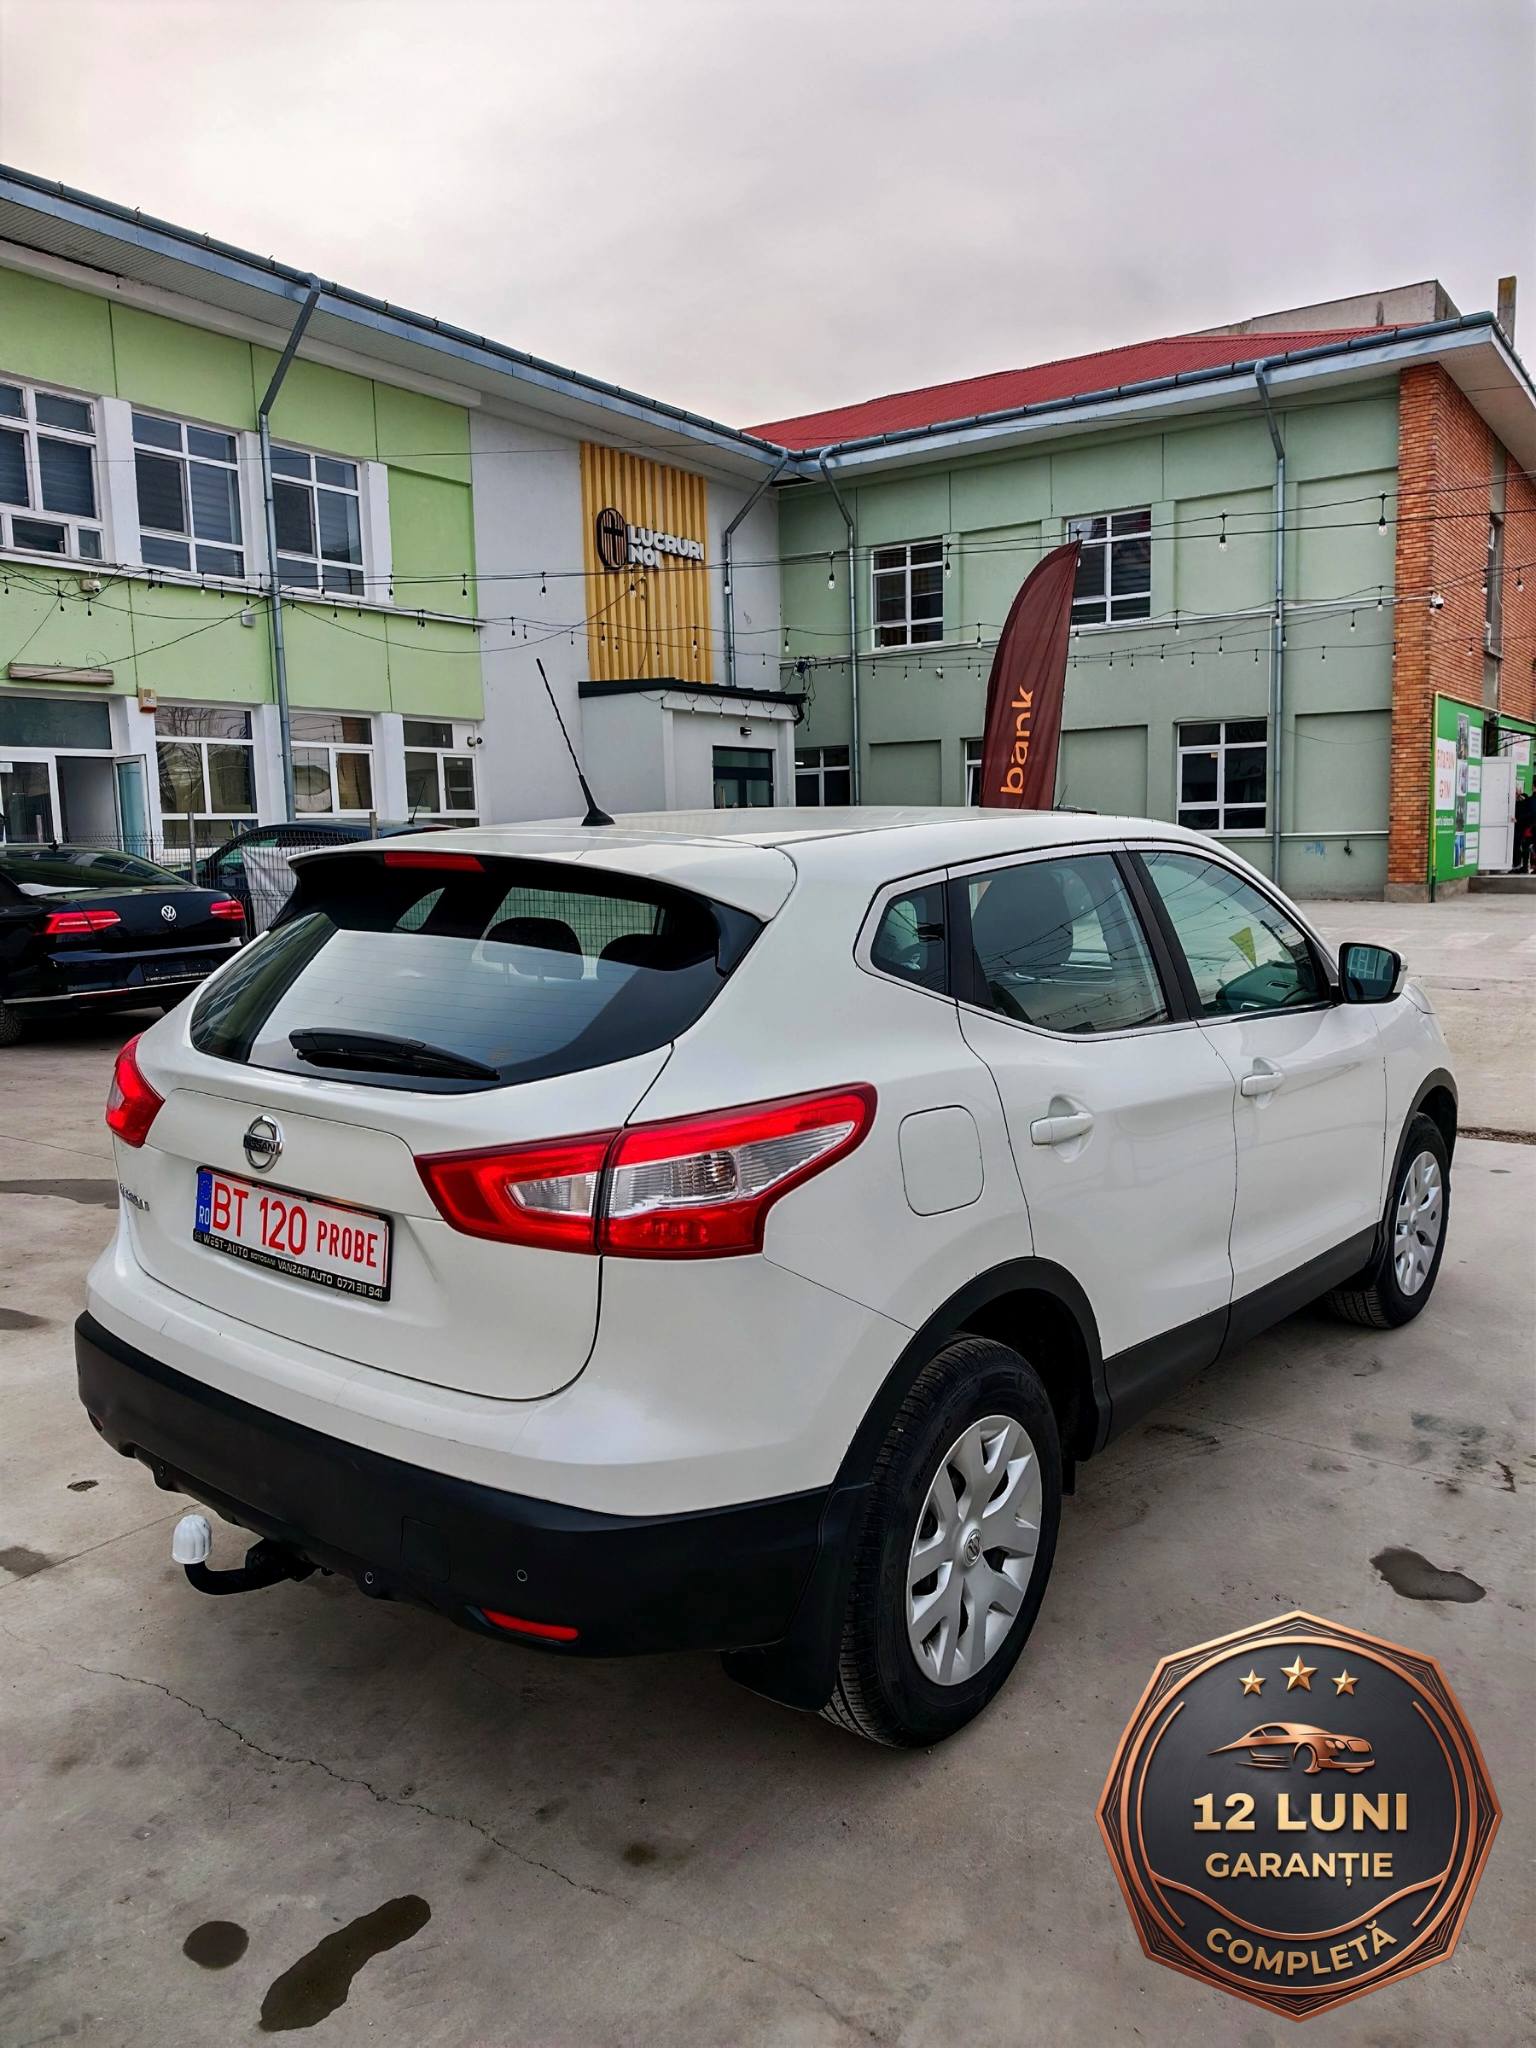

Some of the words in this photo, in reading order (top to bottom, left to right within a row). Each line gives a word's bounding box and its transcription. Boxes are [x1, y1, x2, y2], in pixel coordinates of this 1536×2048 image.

[628, 524, 704, 560] LUCRURI
[628, 544, 662, 568] NOI
[1000, 685, 1033, 794] bank
[199, 1205, 210, 1225] RO
[213, 1181, 249, 1237] BT
[260, 1197, 307, 1255] 120
[317, 1220, 378, 1268] PROBE
[203, 1234, 249, 1258] WEST-AUTO
[277, 1259, 309, 1278] VANZARI
[310, 1270, 333, 1285] AUTO
[337, 1277, 355, 1291] 0771
[356, 1283, 367, 1294] 311
[368, 1287, 383, 1299] 941
